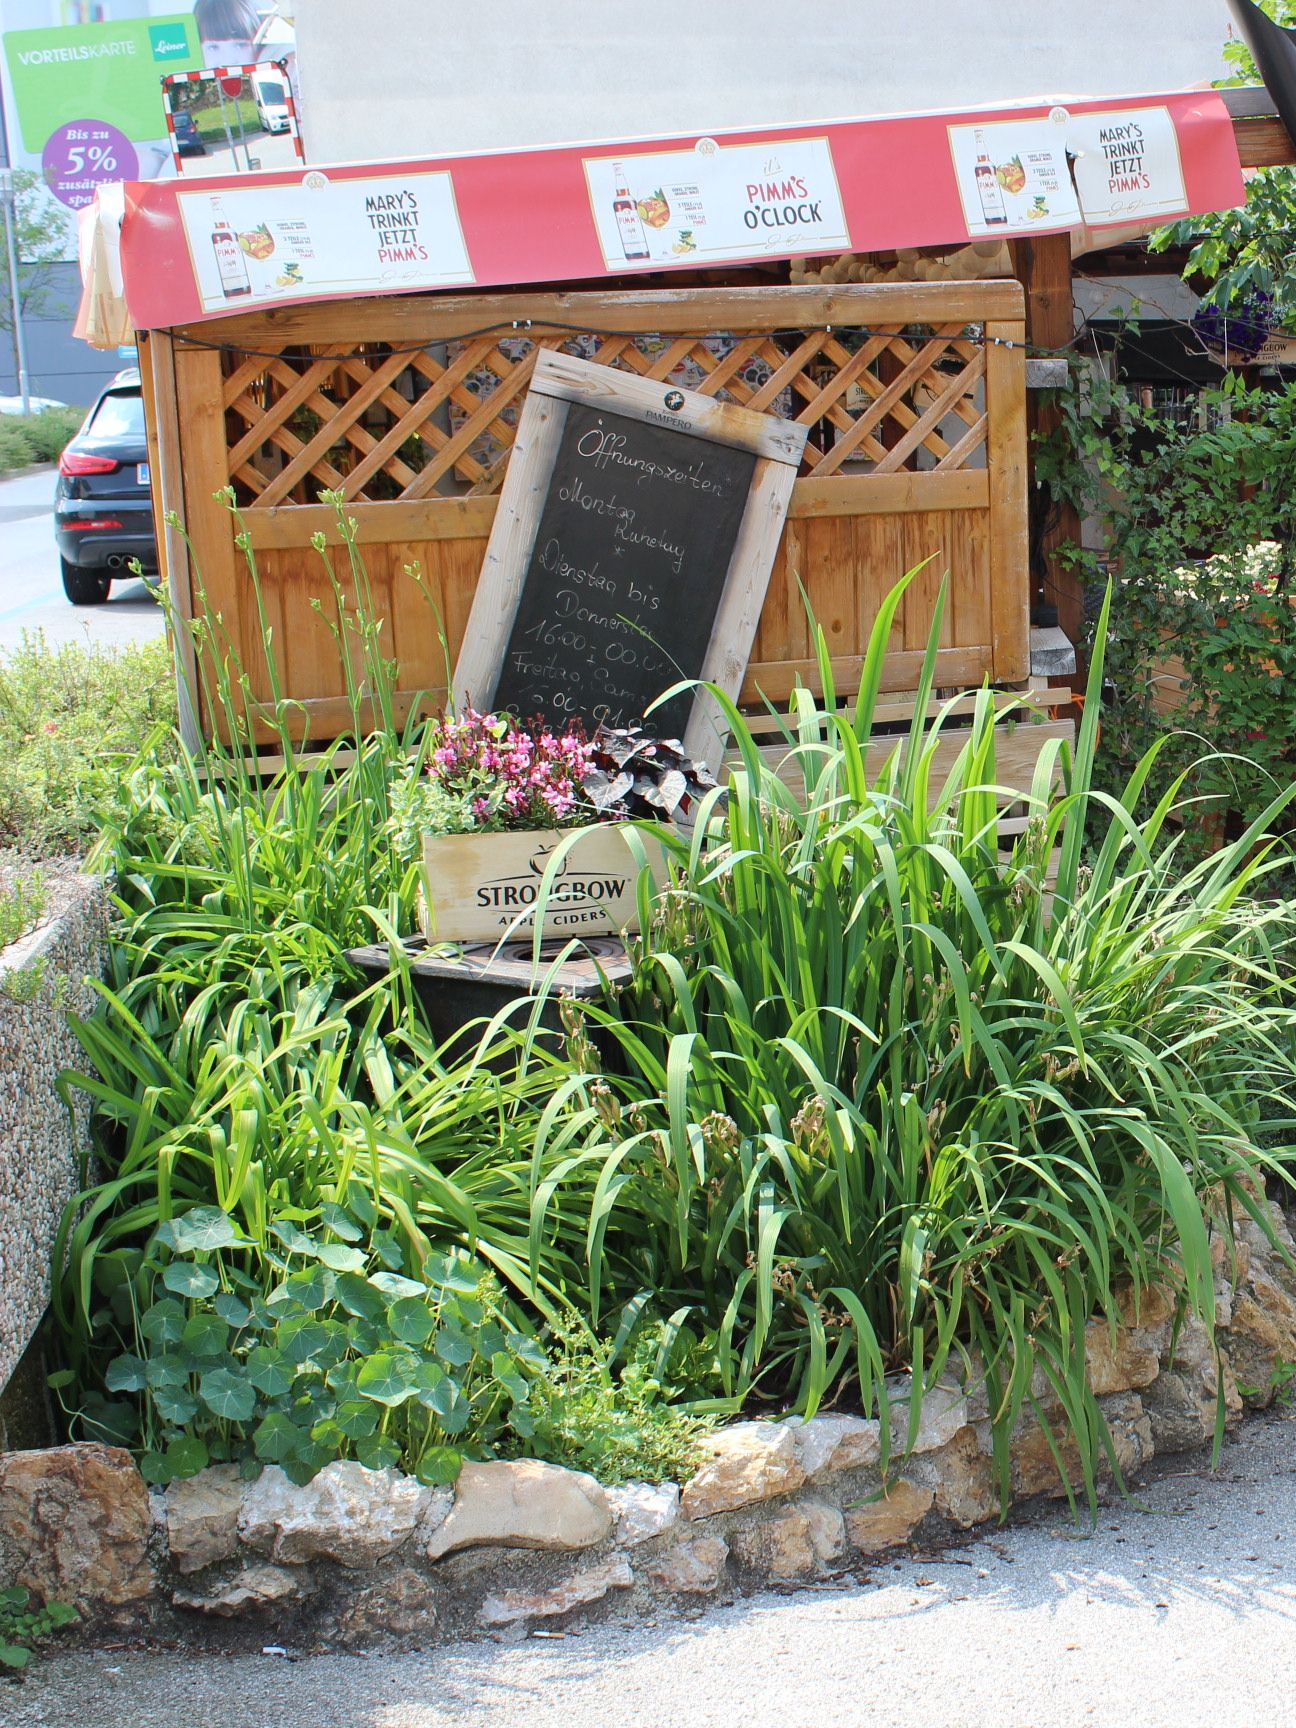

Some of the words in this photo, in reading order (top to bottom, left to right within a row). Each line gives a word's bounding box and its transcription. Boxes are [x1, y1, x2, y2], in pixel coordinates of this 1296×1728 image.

[18, 41, 136, 65] VORTEILSKARTE
[155, 40, 186, 55] Leiner
[66, 129, 89, 140] Bis
[93, 130, 109, 139] zu
[1100, 123, 1142, 143] MARY'S
[1102, 140, 1144, 159] TRINKT
[64, 146, 118, 175] 5%
[1110, 157, 1142, 178] JETZT
[746, 176, 808, 203] PIMM'S
[1108, 172, 1150, 193] PIMM'S
[365, 190, 417, 212] MARY'S
[368, 211, 419, 229] TRINKT
[744, 203, 822, 229] O'CLOCK
[378, 229, 417, 248] JETZT
[378, 244, 428, 263] PIMM'S
[645, 410, 692, 430] PAMPERO
[577, 418, 724, 497] Öffnungszeiten
[558, 477, 636, 524] Montag
[538, 538, 617, 598] Dienstag
[628, 582, 660, 610] bis
[499, 916, 544, 927] APL
[554, 909, 607, 926] CIDERS
